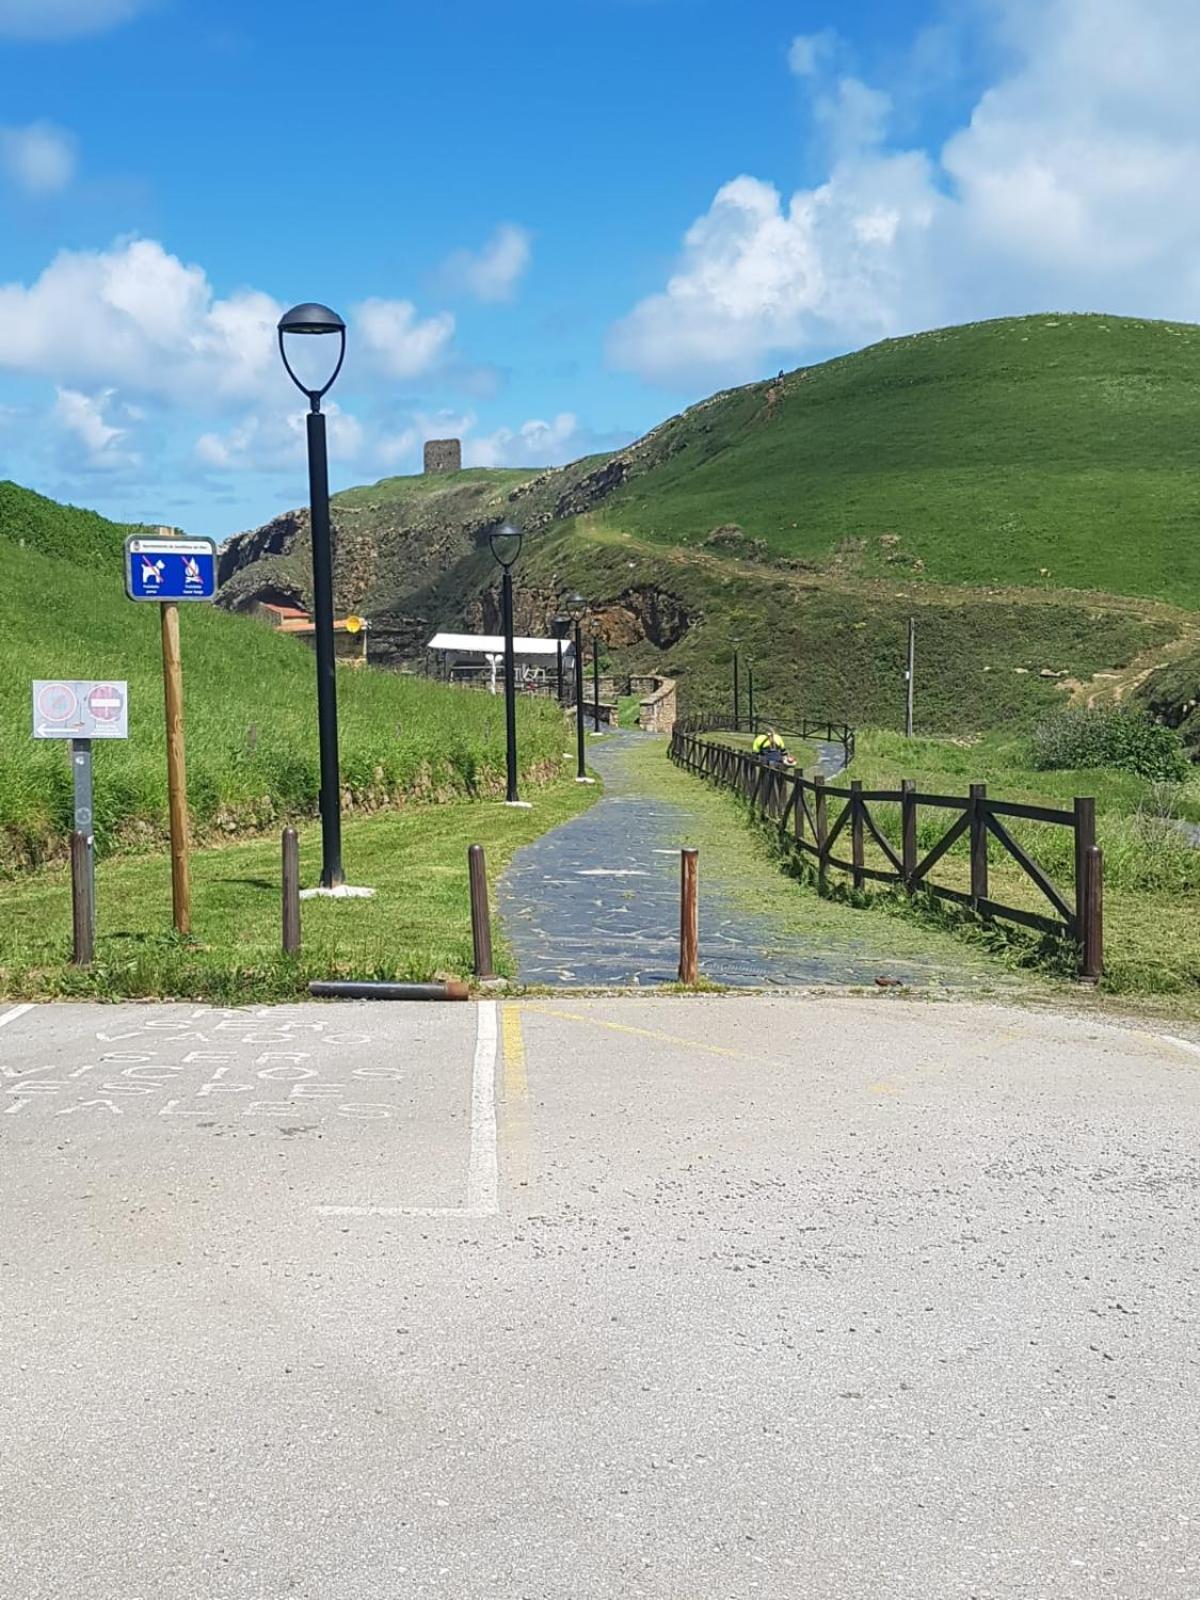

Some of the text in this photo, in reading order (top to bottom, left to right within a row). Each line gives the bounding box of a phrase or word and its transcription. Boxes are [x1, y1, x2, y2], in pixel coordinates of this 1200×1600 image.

[141, 1019, 328, 1032] SER
[96, 1031, 372, 1044] VADO
[99, 1051, 312, 1063] SER
[0, 1065, 408, 1080] VICIOS
[5, 1080, 347, 1097] ESPE
